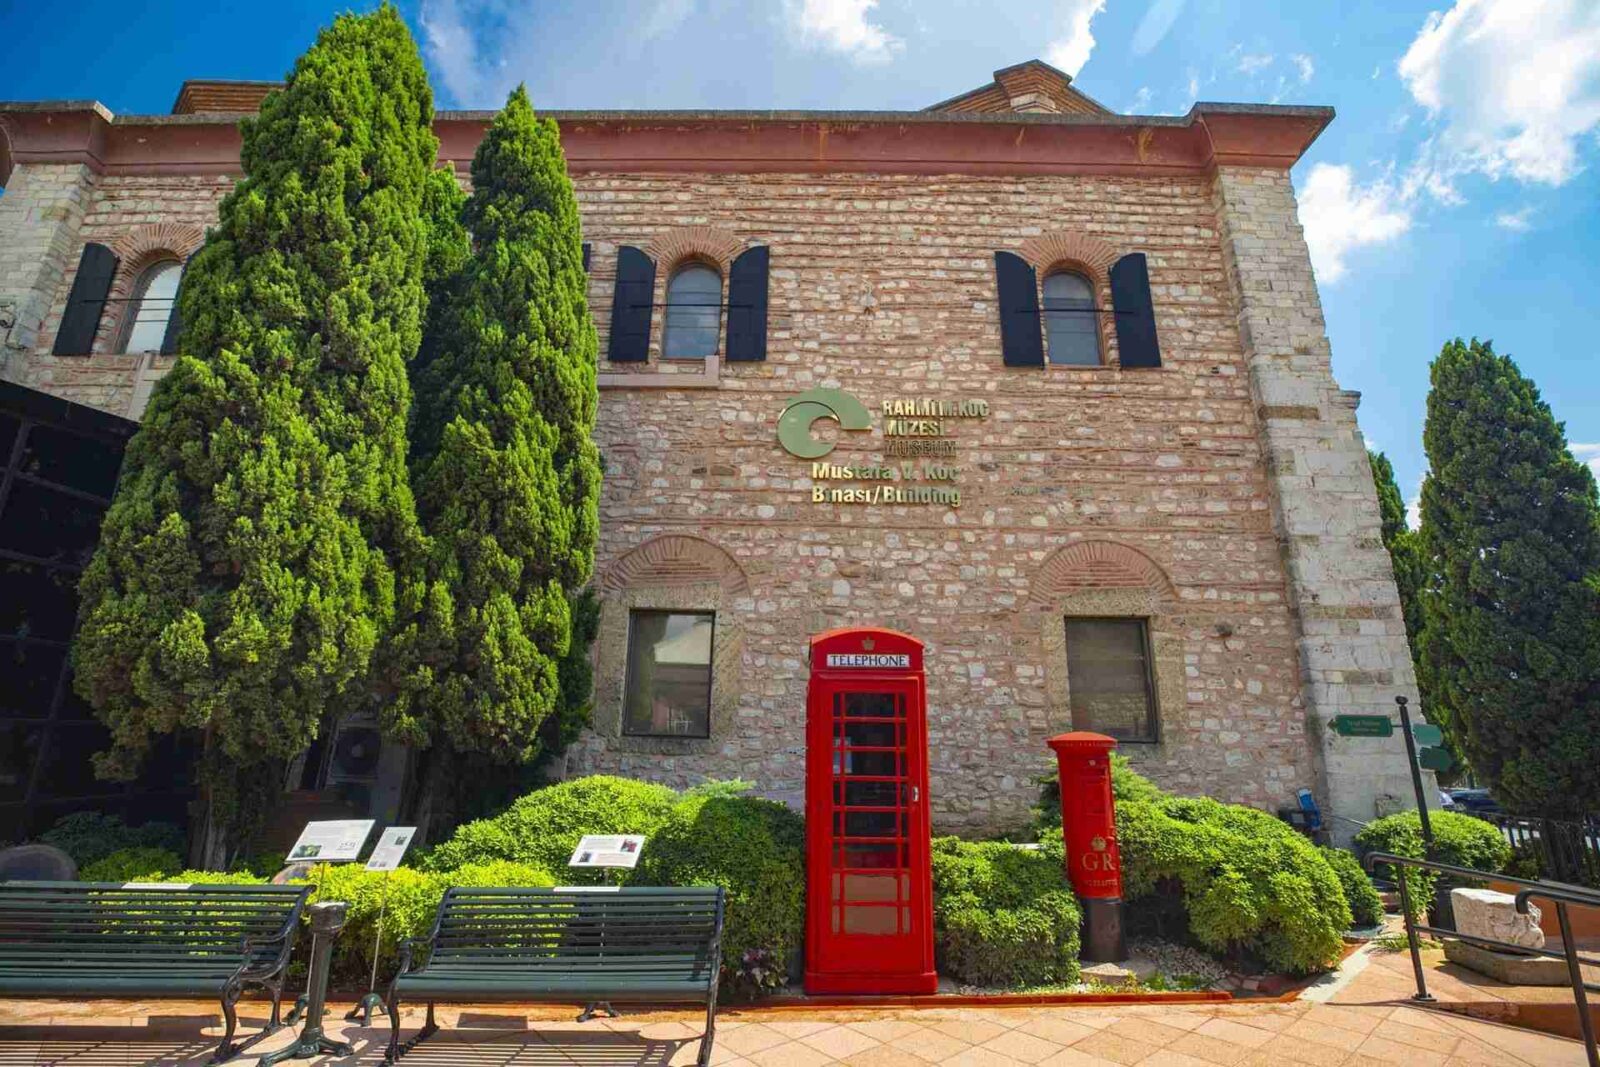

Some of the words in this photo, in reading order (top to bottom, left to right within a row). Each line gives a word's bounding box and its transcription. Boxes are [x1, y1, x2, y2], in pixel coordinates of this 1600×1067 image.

[884, 440, 959, 457] MUSEUM
[812, 462, 893, 480] Mustafa
[830, 655, 907, 666] TELEPHONE
[1082, 852, 1116, 871] GR
